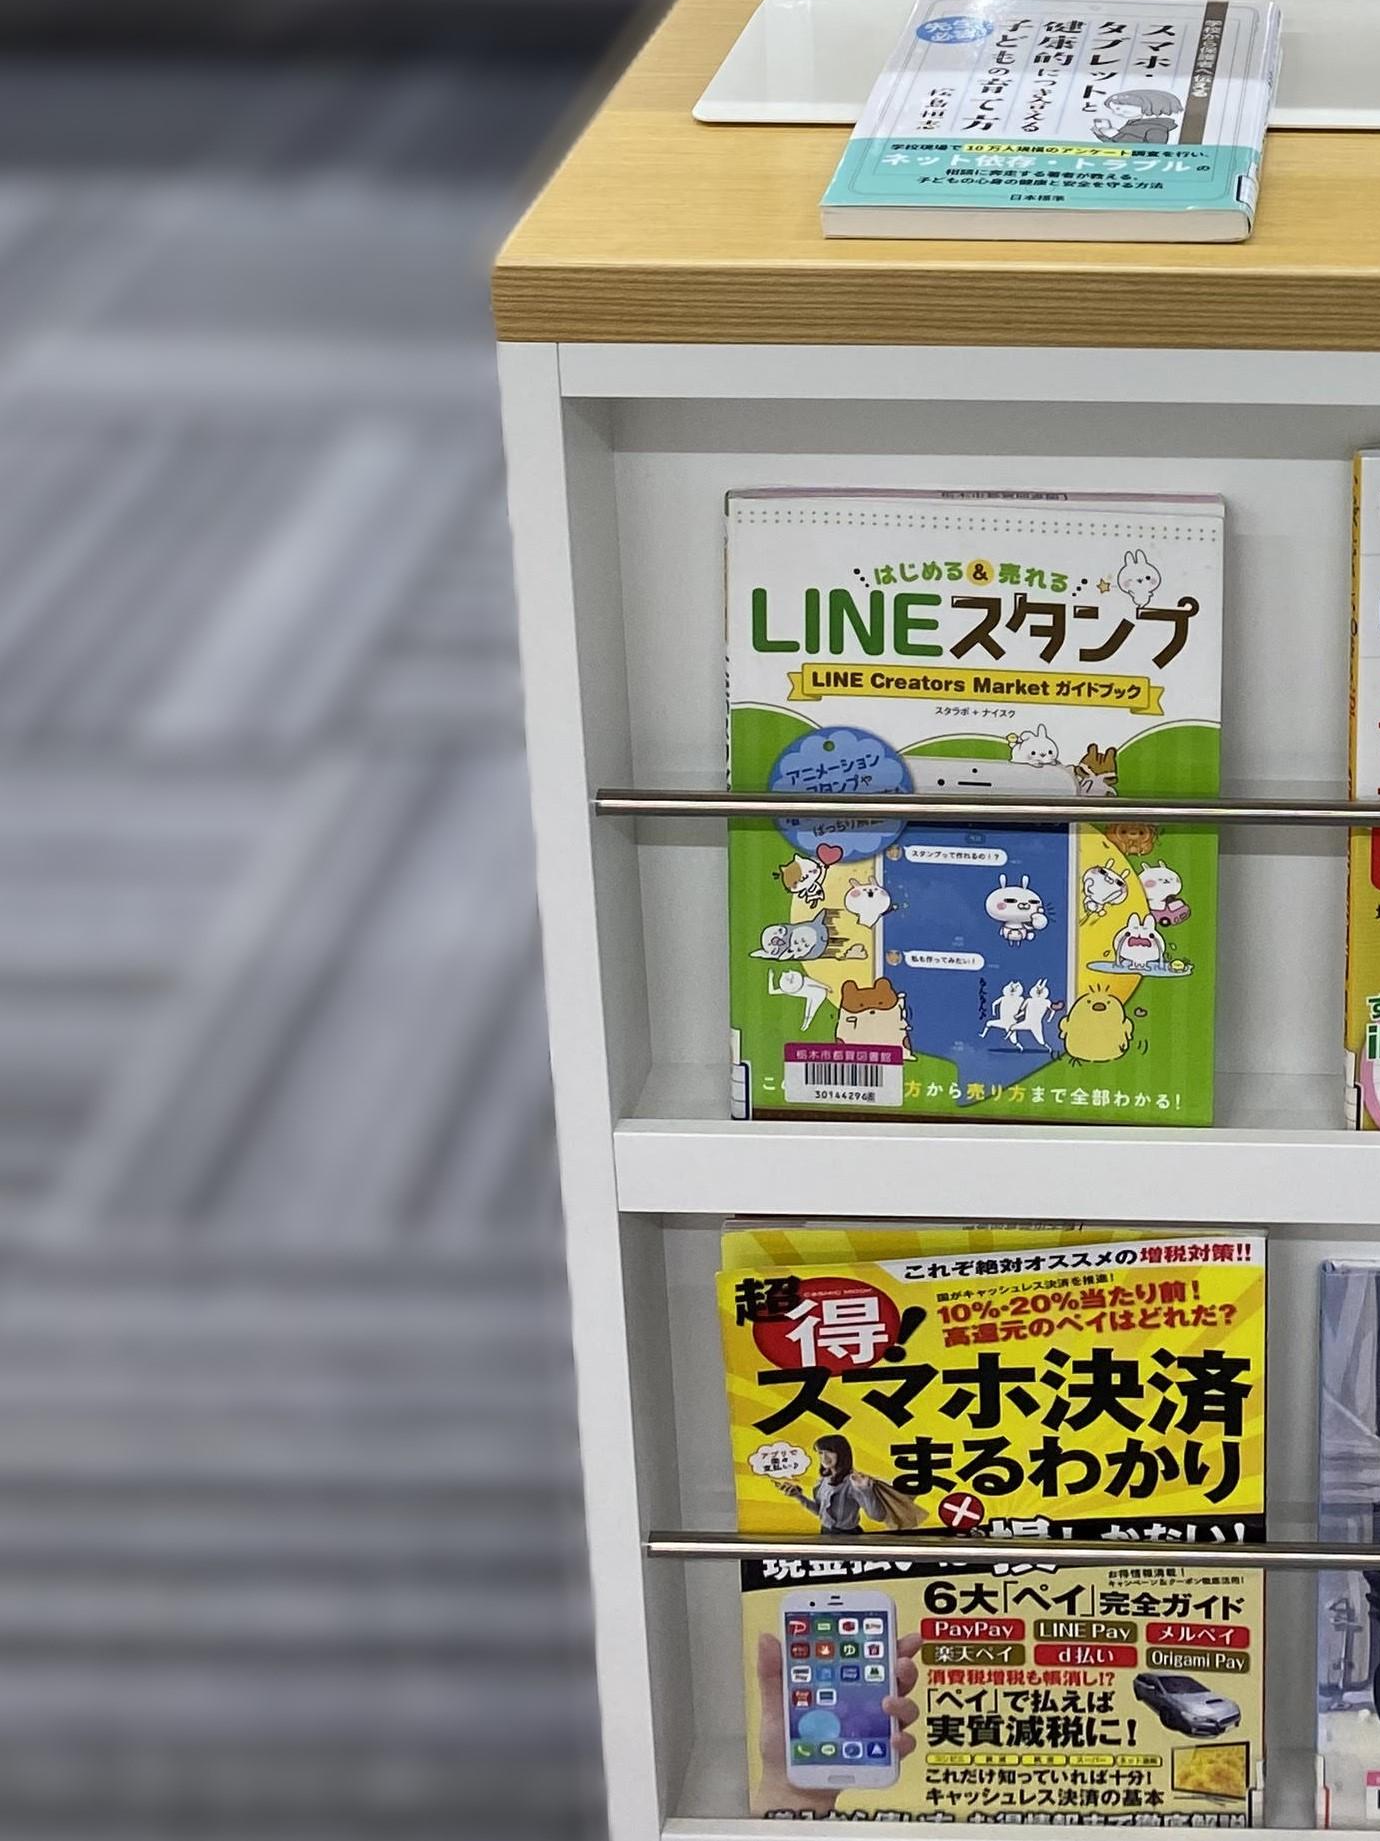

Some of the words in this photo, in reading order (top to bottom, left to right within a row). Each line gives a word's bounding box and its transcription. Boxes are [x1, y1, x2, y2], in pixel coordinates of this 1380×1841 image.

[961, 19, 1033, 131] 子どもの育て方
[1082, 21, 1130, 112] タブレットと
[751, 587, 1200, 669] LINEスタンプ
[812, 670, 863, 689] LINE
[871, 672, 966, 693] Creators
[973, 676, 1050, 696] Market
[1055, 680, 1142, 700] ガイドブック
[786, 754, 880, 786] アニメーション
[796, 1049, 892, 1063] 栃木市都賀図書館
[815, 1090, 876, 1102] 30144296
[735, 1275, 801, 1326] 超
[937, 1273, 1114, 1302] 国がキャッシュレス決済を推進!
[751, 1347, 1253, 1436] スマホ決済
[890, 1436, 1241, 1504] まるわかり
[1108, 1568, 1185, 1579] お得情報満載!
[921, 1580, 1245, 1621] 6大「ペイ」完全ガイド
[934, 1621, 1014, 1640] PayPay
[1038, 1621, 1089, 1640] LINE
[1090, 1623, 1131, 1643] Pay
[1157, 1627, 1236, 1645] メルペイ
[934, 1646, 1014, 1664] 楽天ペイ
[1151, 1652, 1211, 1671] Origami
[1214, 1654, 1246, 1673] Pay
[927, 1689, 1114, 1716] 「ペイ」で払えば
[926, 1717, 1138, 1748] 実質減税に!
[926, 1769, 1152, 1786] これだけ知っていれば十分!
[926, 1788, 1164, 1807] キャッシュレス決済の基本
